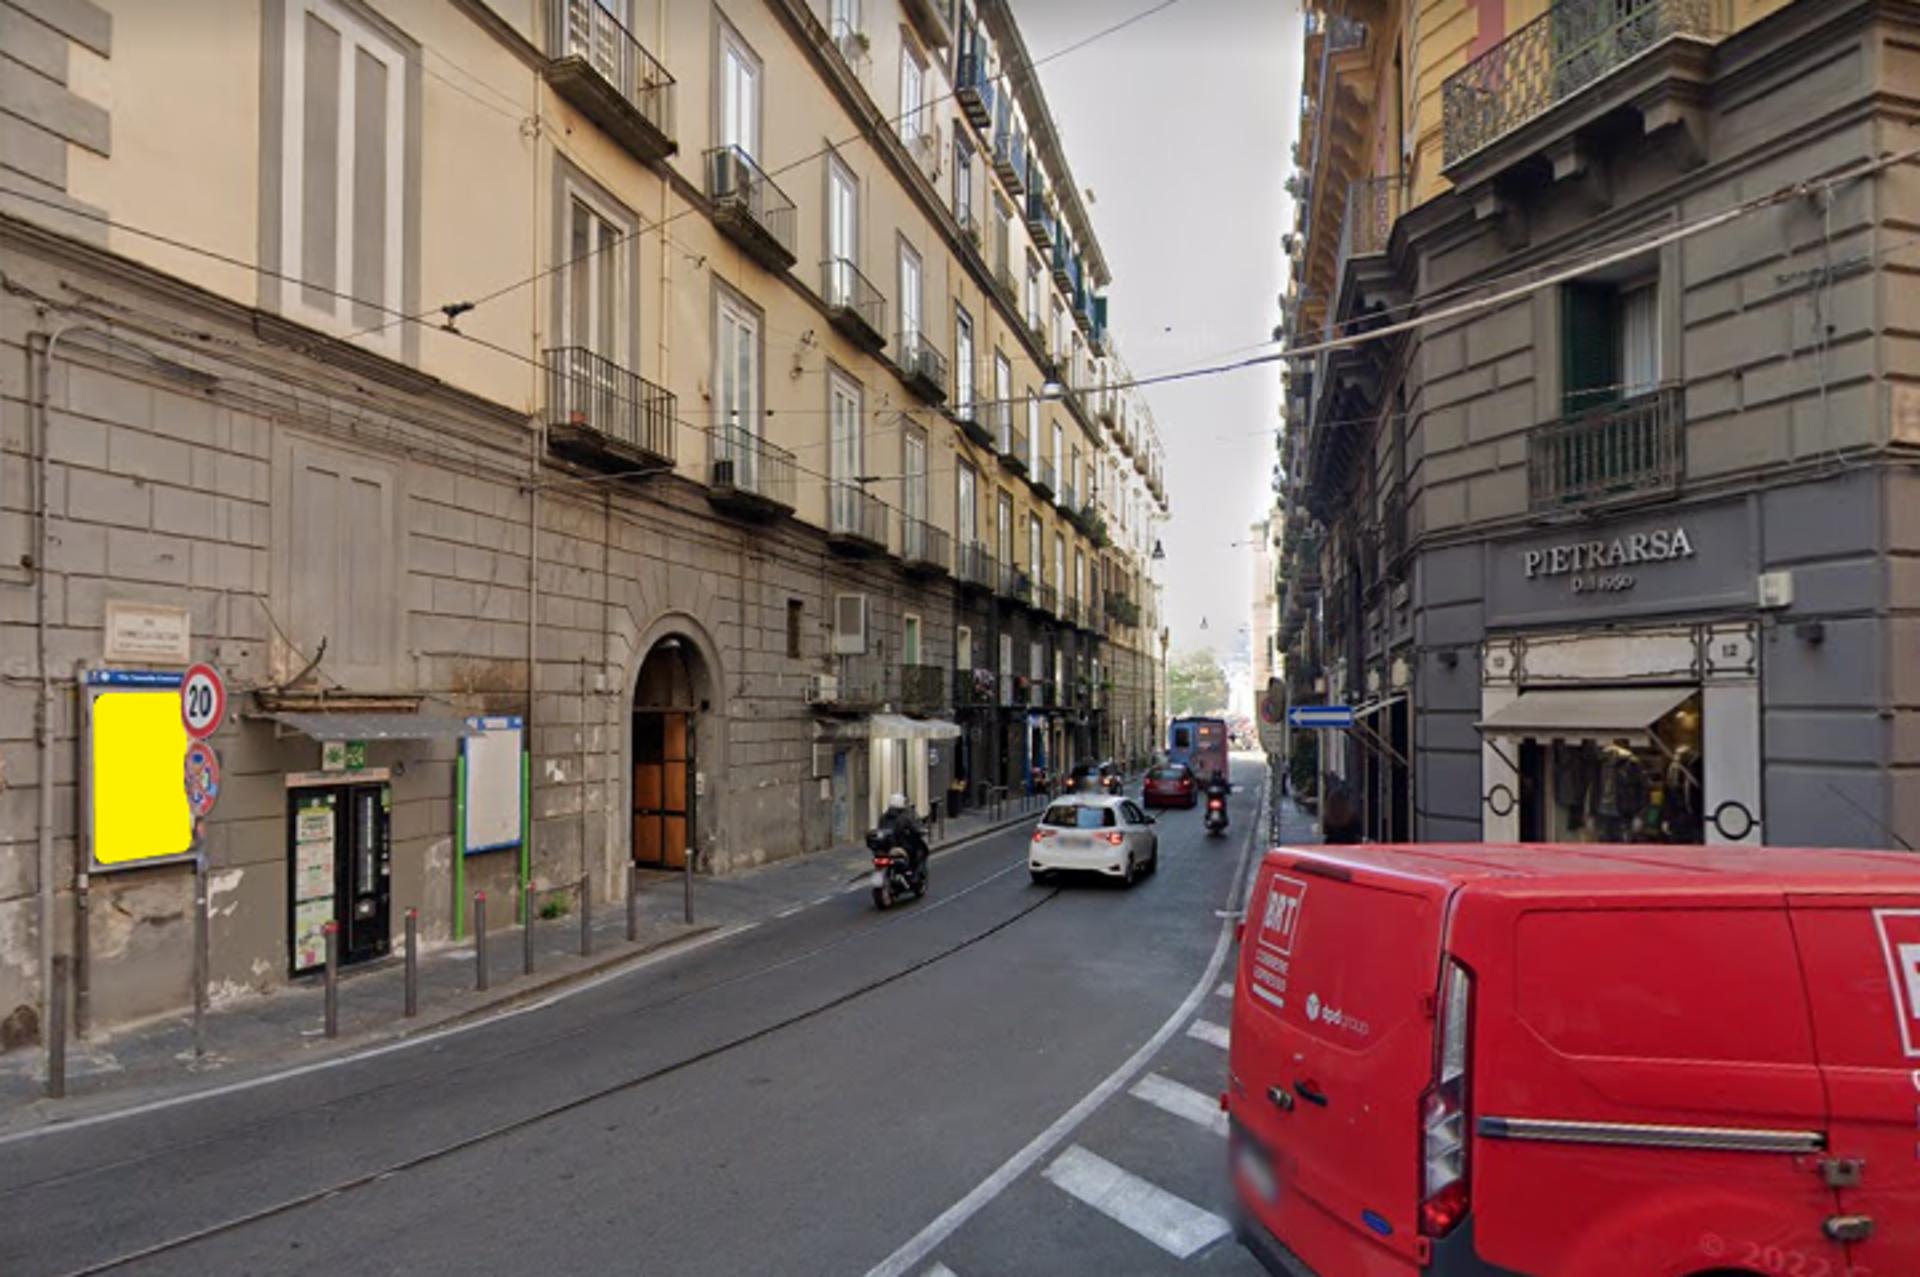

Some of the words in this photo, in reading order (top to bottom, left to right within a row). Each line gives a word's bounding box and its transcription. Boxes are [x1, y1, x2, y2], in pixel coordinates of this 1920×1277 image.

[1525, 527, 1692, 576] PIETRARSA
[1722, 643, 1738, 658] 12
[188, 684, 212, 718] 20
